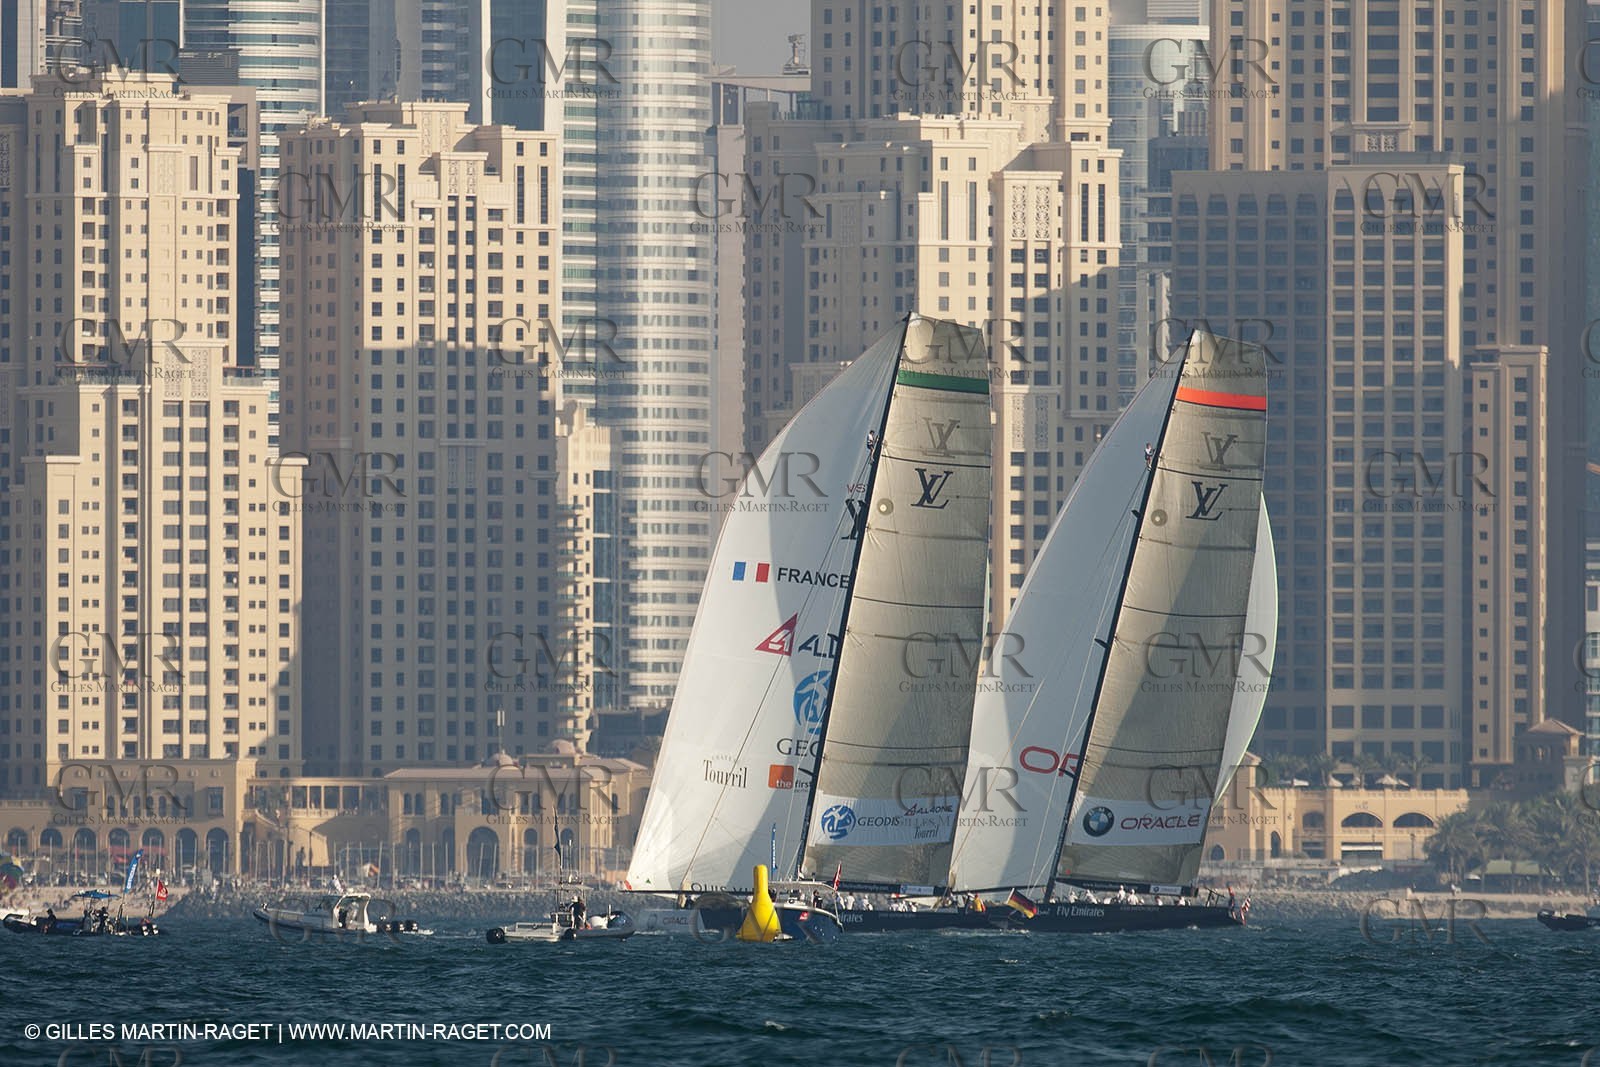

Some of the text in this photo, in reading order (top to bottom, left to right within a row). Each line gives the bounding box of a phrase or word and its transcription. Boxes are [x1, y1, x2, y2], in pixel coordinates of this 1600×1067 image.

[777, 567, 850, 589] FRANCE
[703, 759, 748, 788] Tourril
[775, 779, 811, 789] the firs
[857, 816, 900, 827] GEODIS
[1120, 814, 1201, 830] ORACLE
[1056, 905, 1071, 917] Fly
[1071, 906, 1105, 917] Emirates
